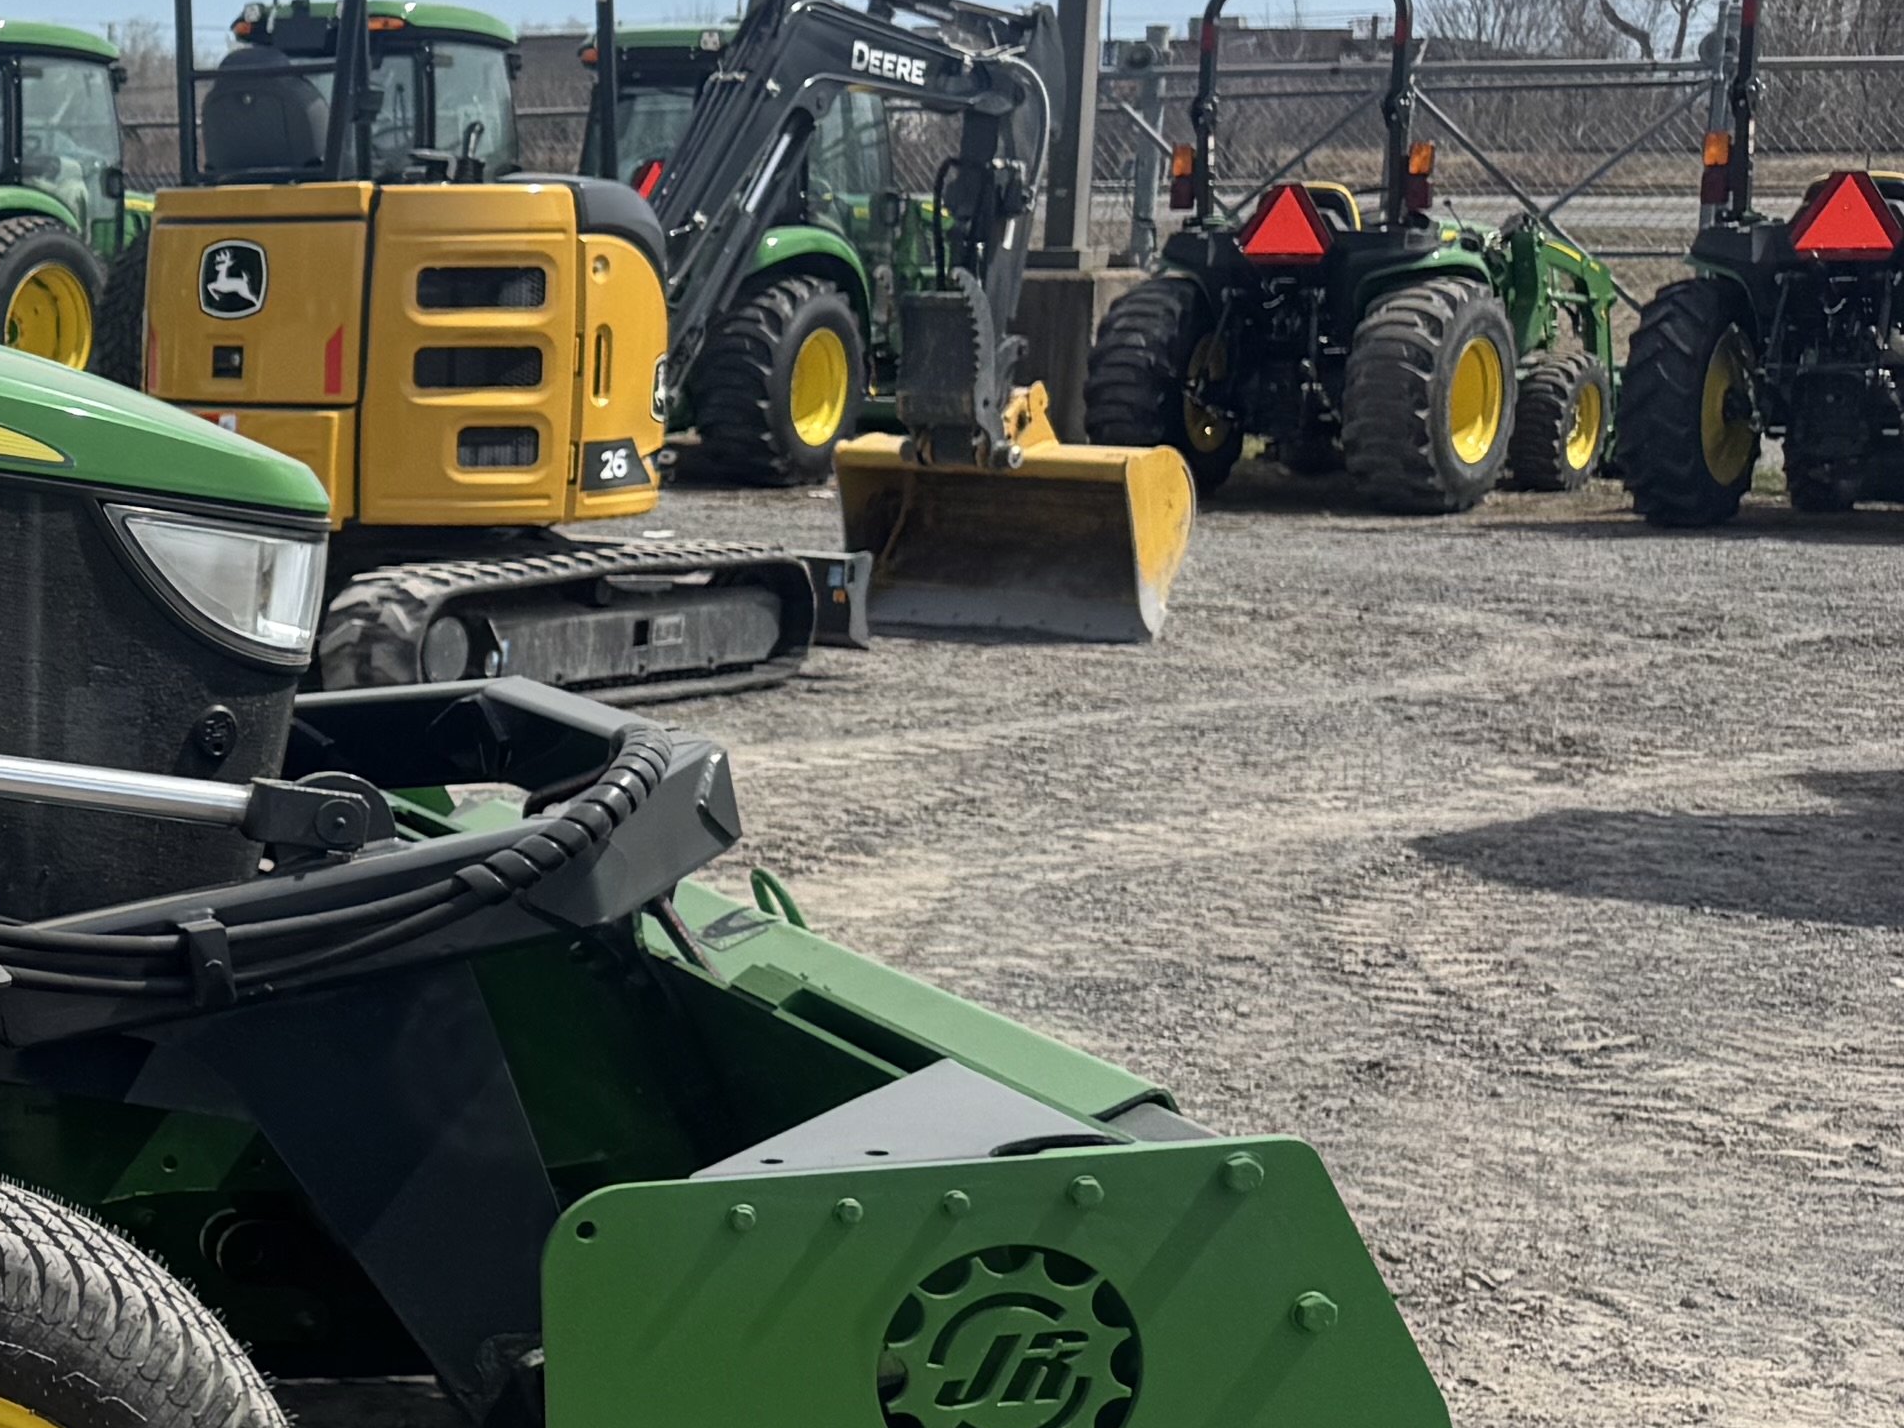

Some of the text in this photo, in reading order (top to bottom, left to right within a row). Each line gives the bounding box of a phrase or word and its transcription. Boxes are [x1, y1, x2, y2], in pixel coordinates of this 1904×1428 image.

[851, 39, 927, 86] DEERE
[599, 448, 628, 480] 26
[934, 1330, 1089, 1411] JR
